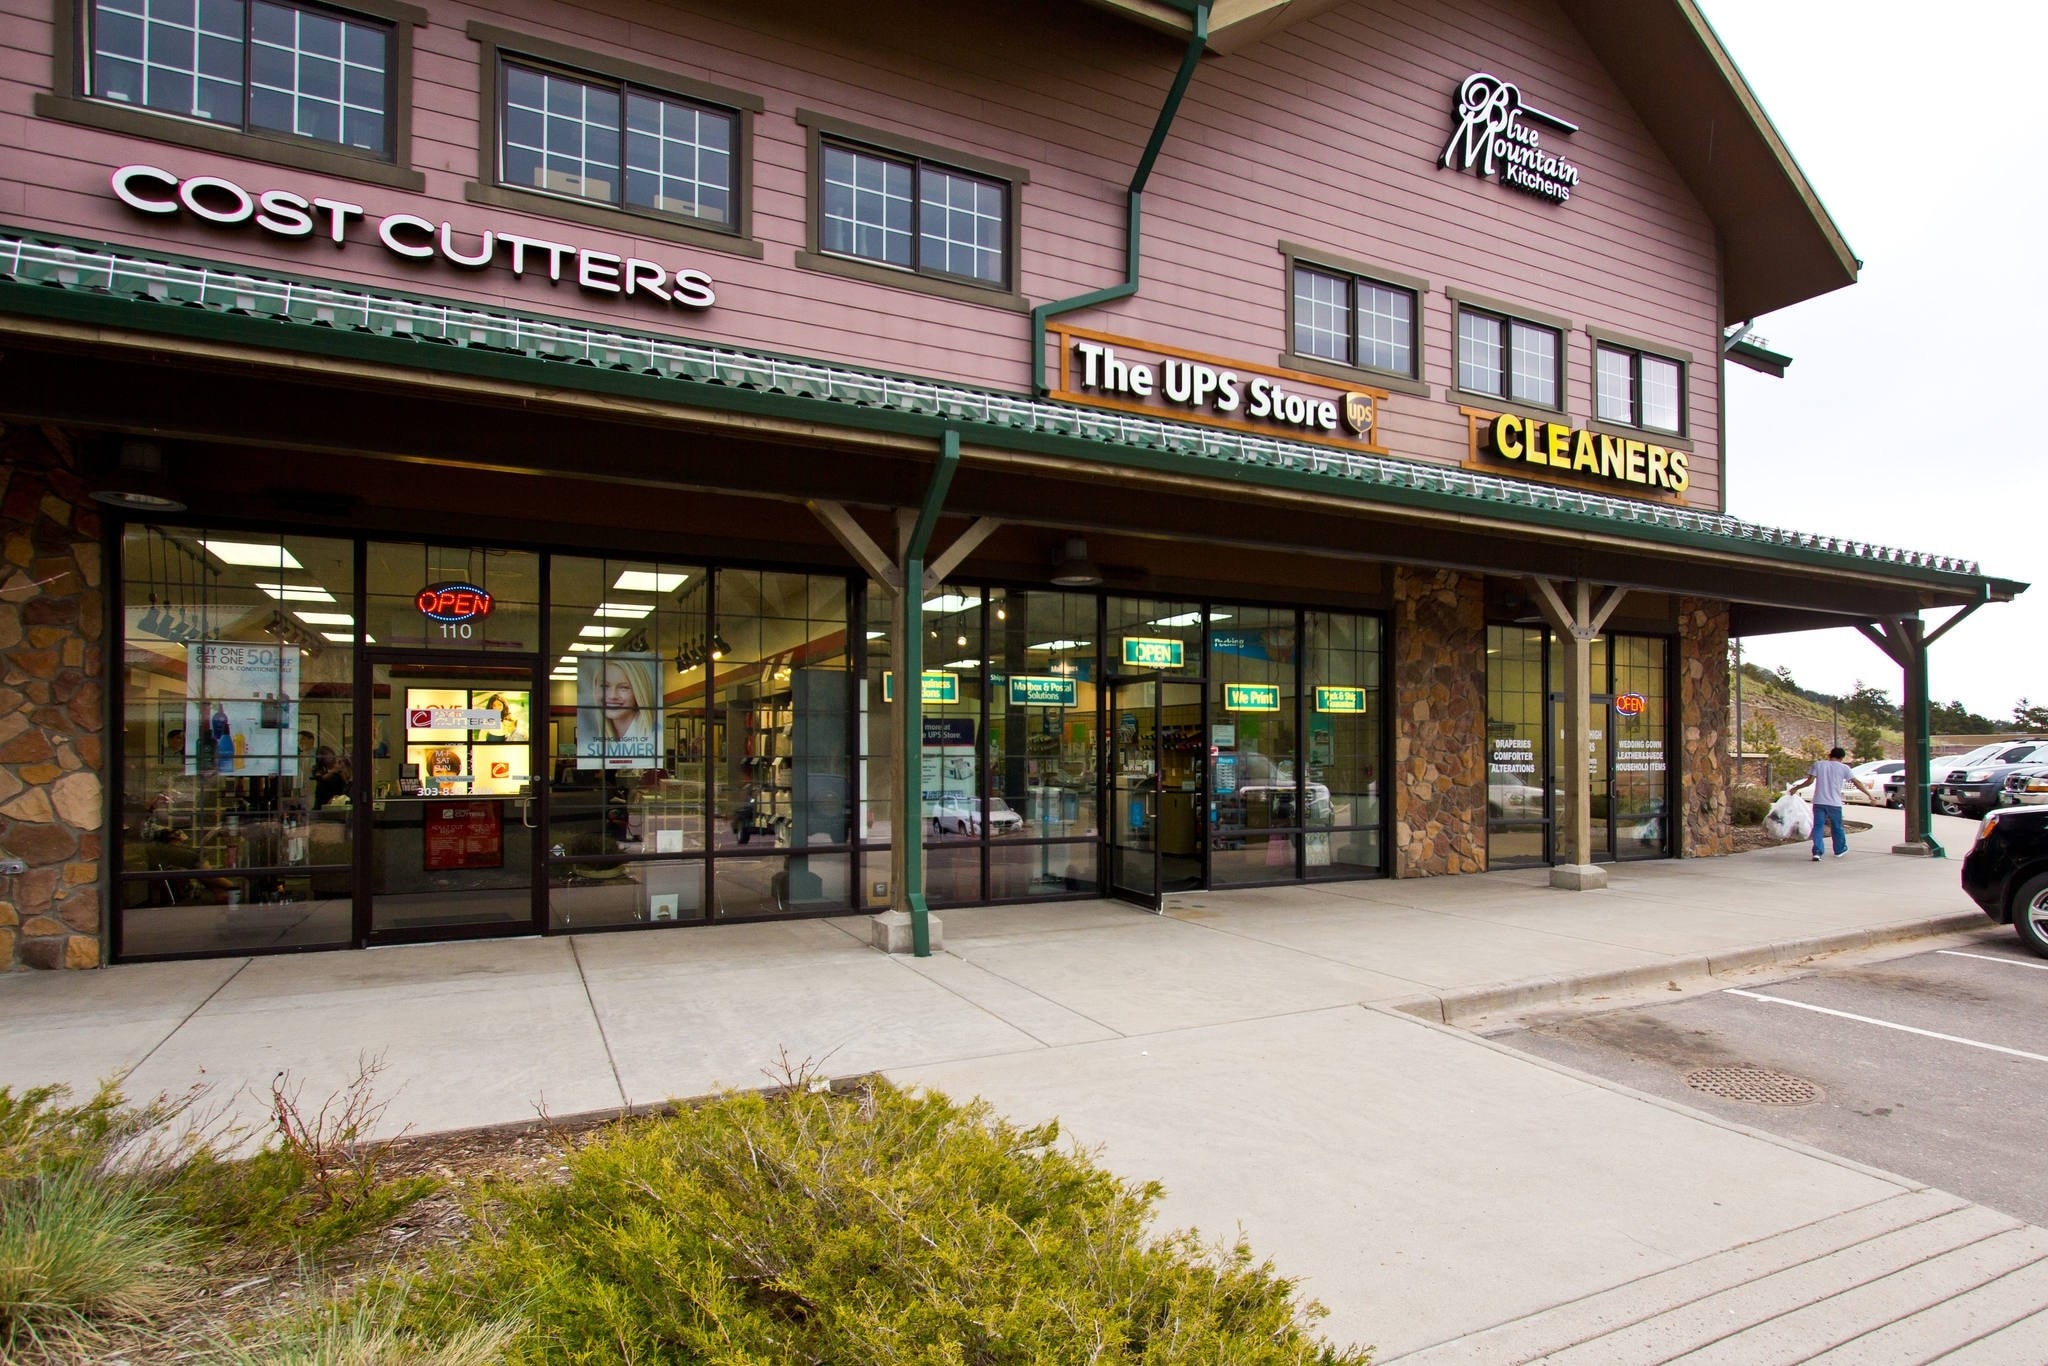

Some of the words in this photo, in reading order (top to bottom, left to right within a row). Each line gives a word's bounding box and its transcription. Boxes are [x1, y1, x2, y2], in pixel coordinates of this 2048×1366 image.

[1461, 73, 1540, 147] Blue
[1445, 104, 1580, 186] Mountain
[1507, 162, 1570, 200] Kitchens
[111, 164, 364, 244] COST
[378, 213, 716, 308] CUTTERS
[1078, 342, 1153, 396] The
[1163, 359, 1239, 412] UPS
[1250, 377, 1338, 431] Store
[1349, 402, 1373, 427] ups
[1494, 413, 1690, 492] CLEANERS
[419, 592, 490, 614] OPEN
[440, 624, 472, 639] 110
[196, 646, 217, 655] BUY
[220, 647, 244, 656] ONE
[1135, 643, 1171, 662] OPEN
[196, 655, 217, 664] GET
[220, 656, 244, 665] ONE
[921, 679, 951, 689] usiness
[1051, 683, 1072, 692] Posal
[1027, 691, 1059, 700] Solutions
[1231, 690, 1249, 703] We
[1250, 691, 1274, 704] Print
[1616, 696, 1645, 712] OPEN
[587, 742, 655, 757] SUMMER
[1495, 740, 1532, 749] DRAPERIES
[1618, 740, 1645, 749] WEDDING
[1493, 752, 1533, 761] COMFORTER
[1491, 764, 1536, 773] ALTERATIONS
[1615, 763, 1649, 771] HOUSEHOLD
[1649, 763, 1667, 771] ITEMS
